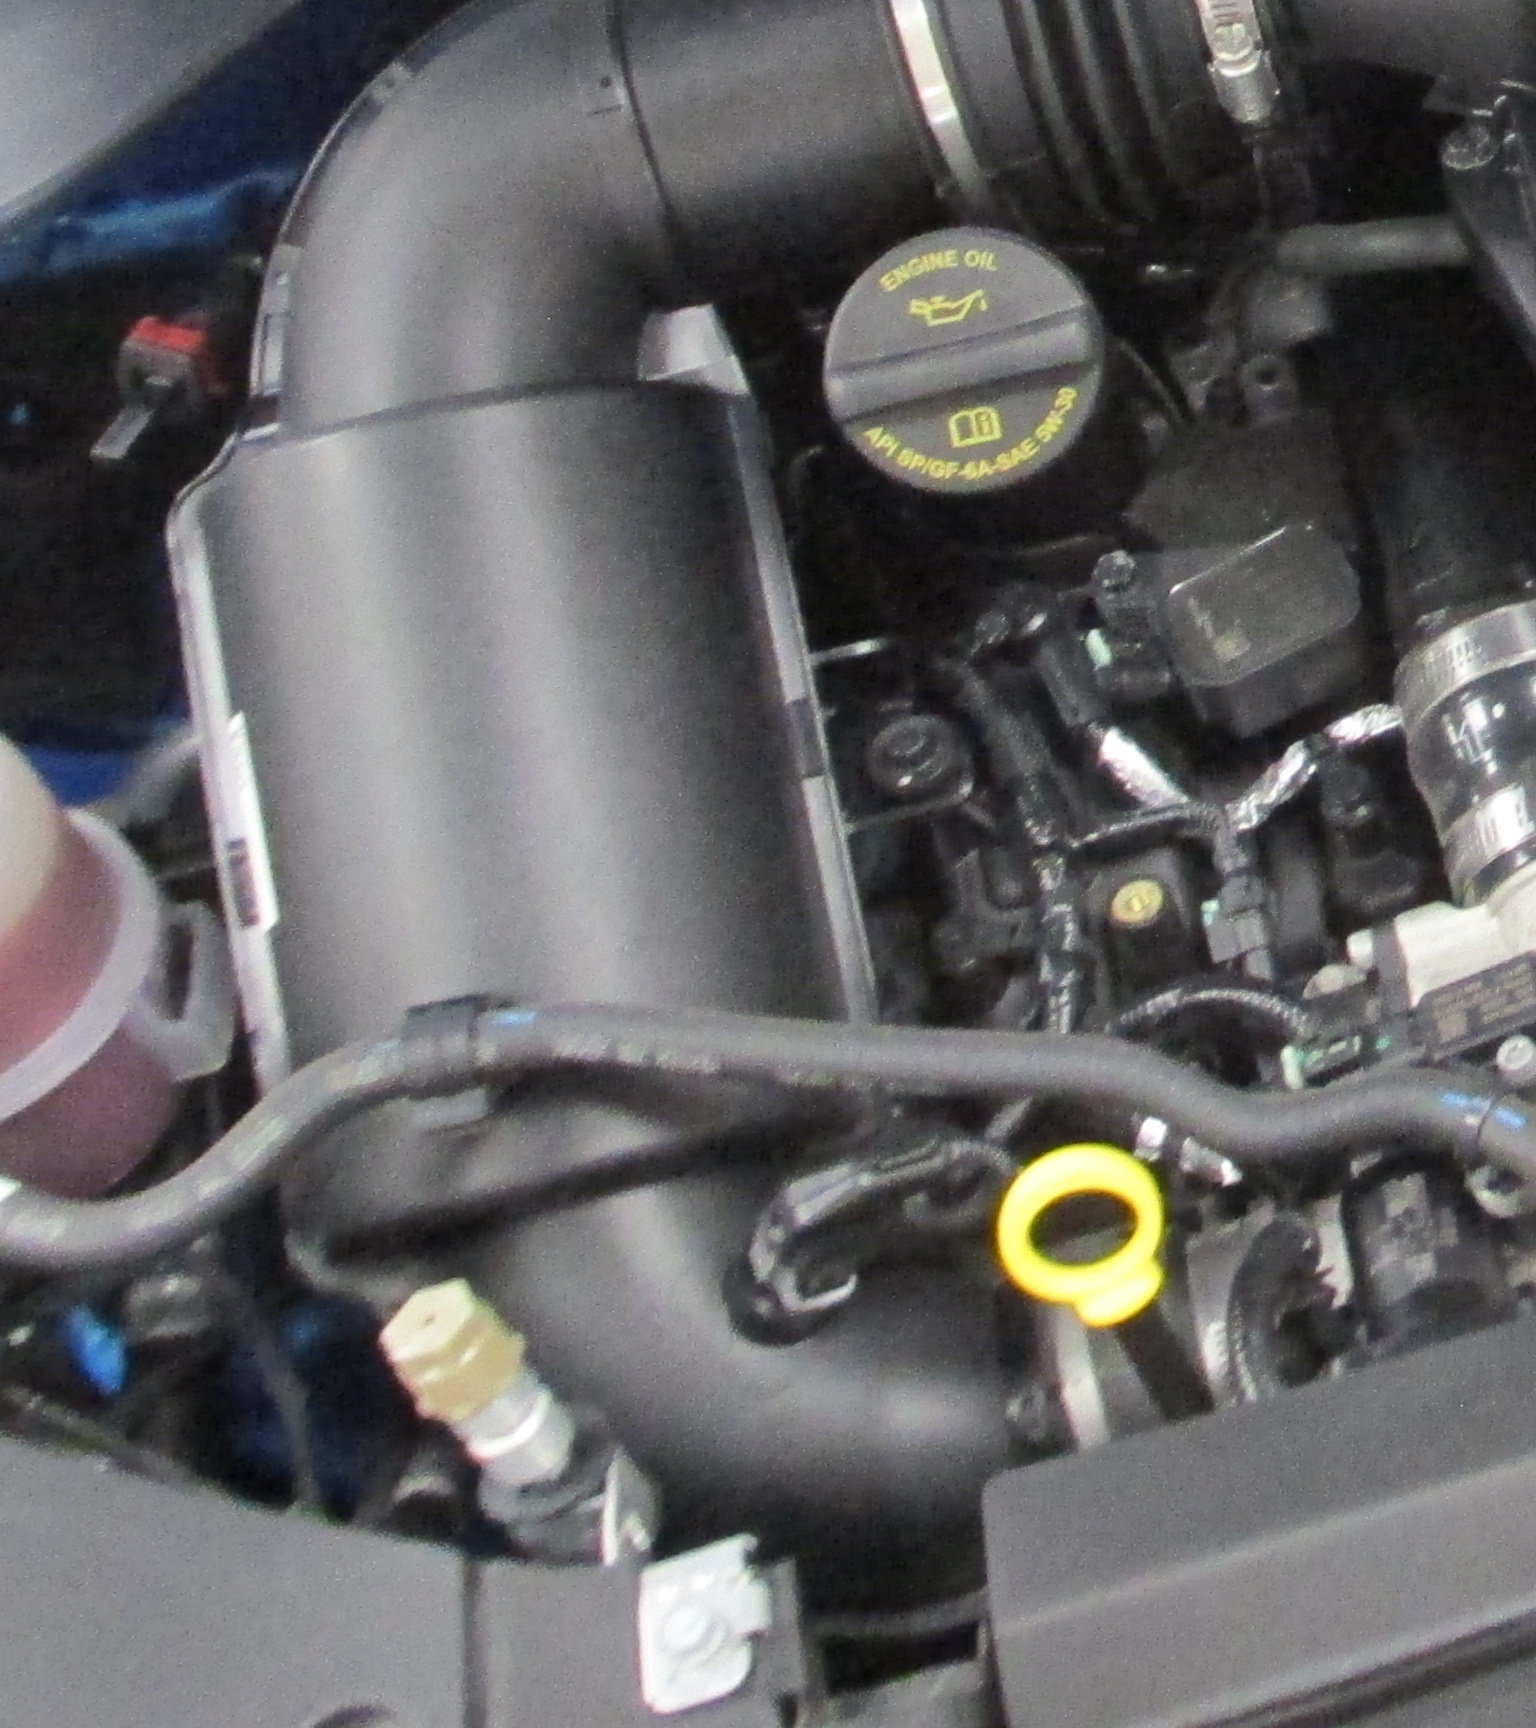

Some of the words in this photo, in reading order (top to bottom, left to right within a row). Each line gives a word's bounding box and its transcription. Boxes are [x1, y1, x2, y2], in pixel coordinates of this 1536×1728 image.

[879, 249, 959, 292] ENGINE
[963, 248, 999, 271] OIL
[862, 426, 900, 457] API
